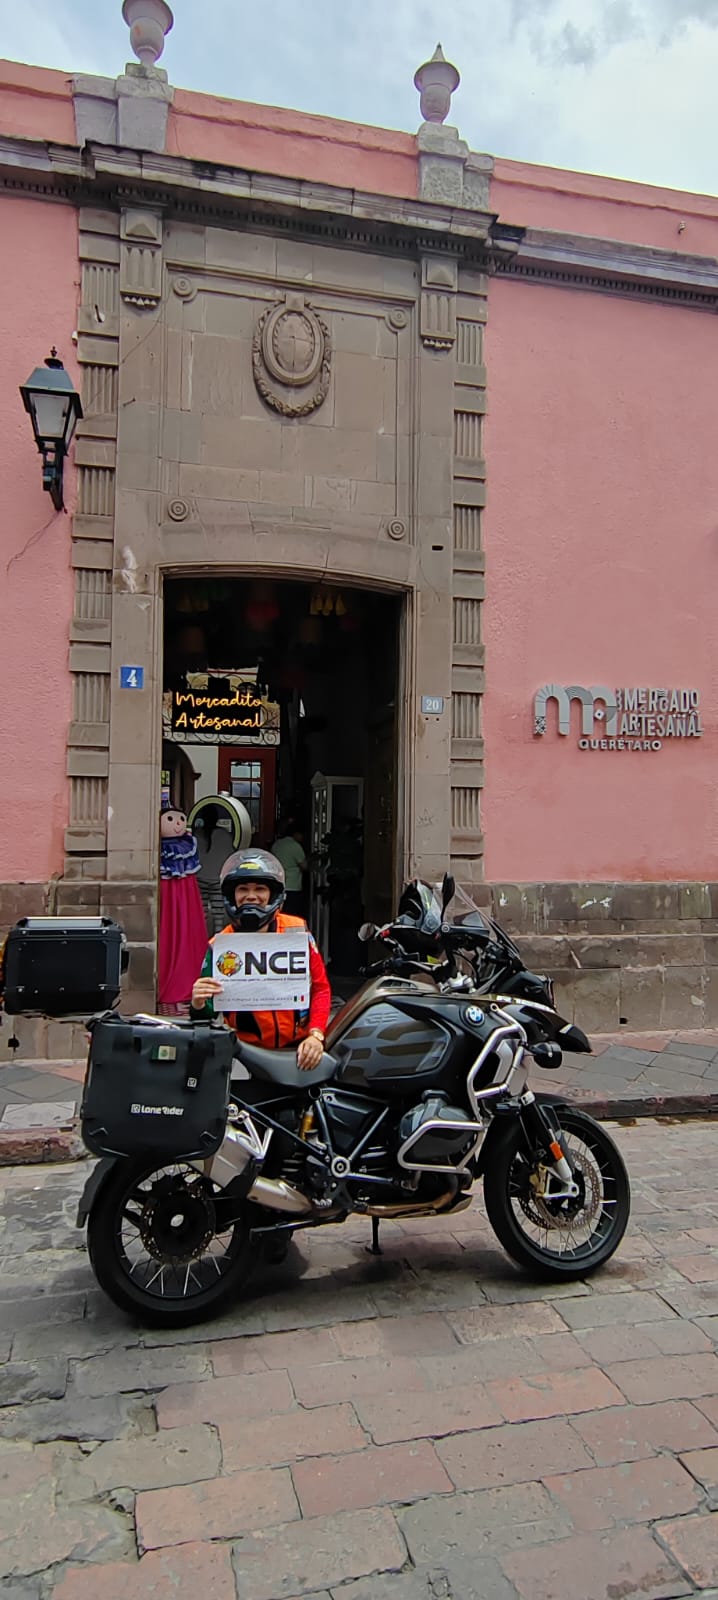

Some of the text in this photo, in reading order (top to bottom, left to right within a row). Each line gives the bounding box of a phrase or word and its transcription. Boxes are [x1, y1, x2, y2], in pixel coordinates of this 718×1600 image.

[126, 669, 137, 687] 4
[175, 690, 262, 709] Mercadito
[425, 698, 440, 711] 20
[624, 687, 700, 712] MERCADO
[175, 711, 262, 731] Artesanal
